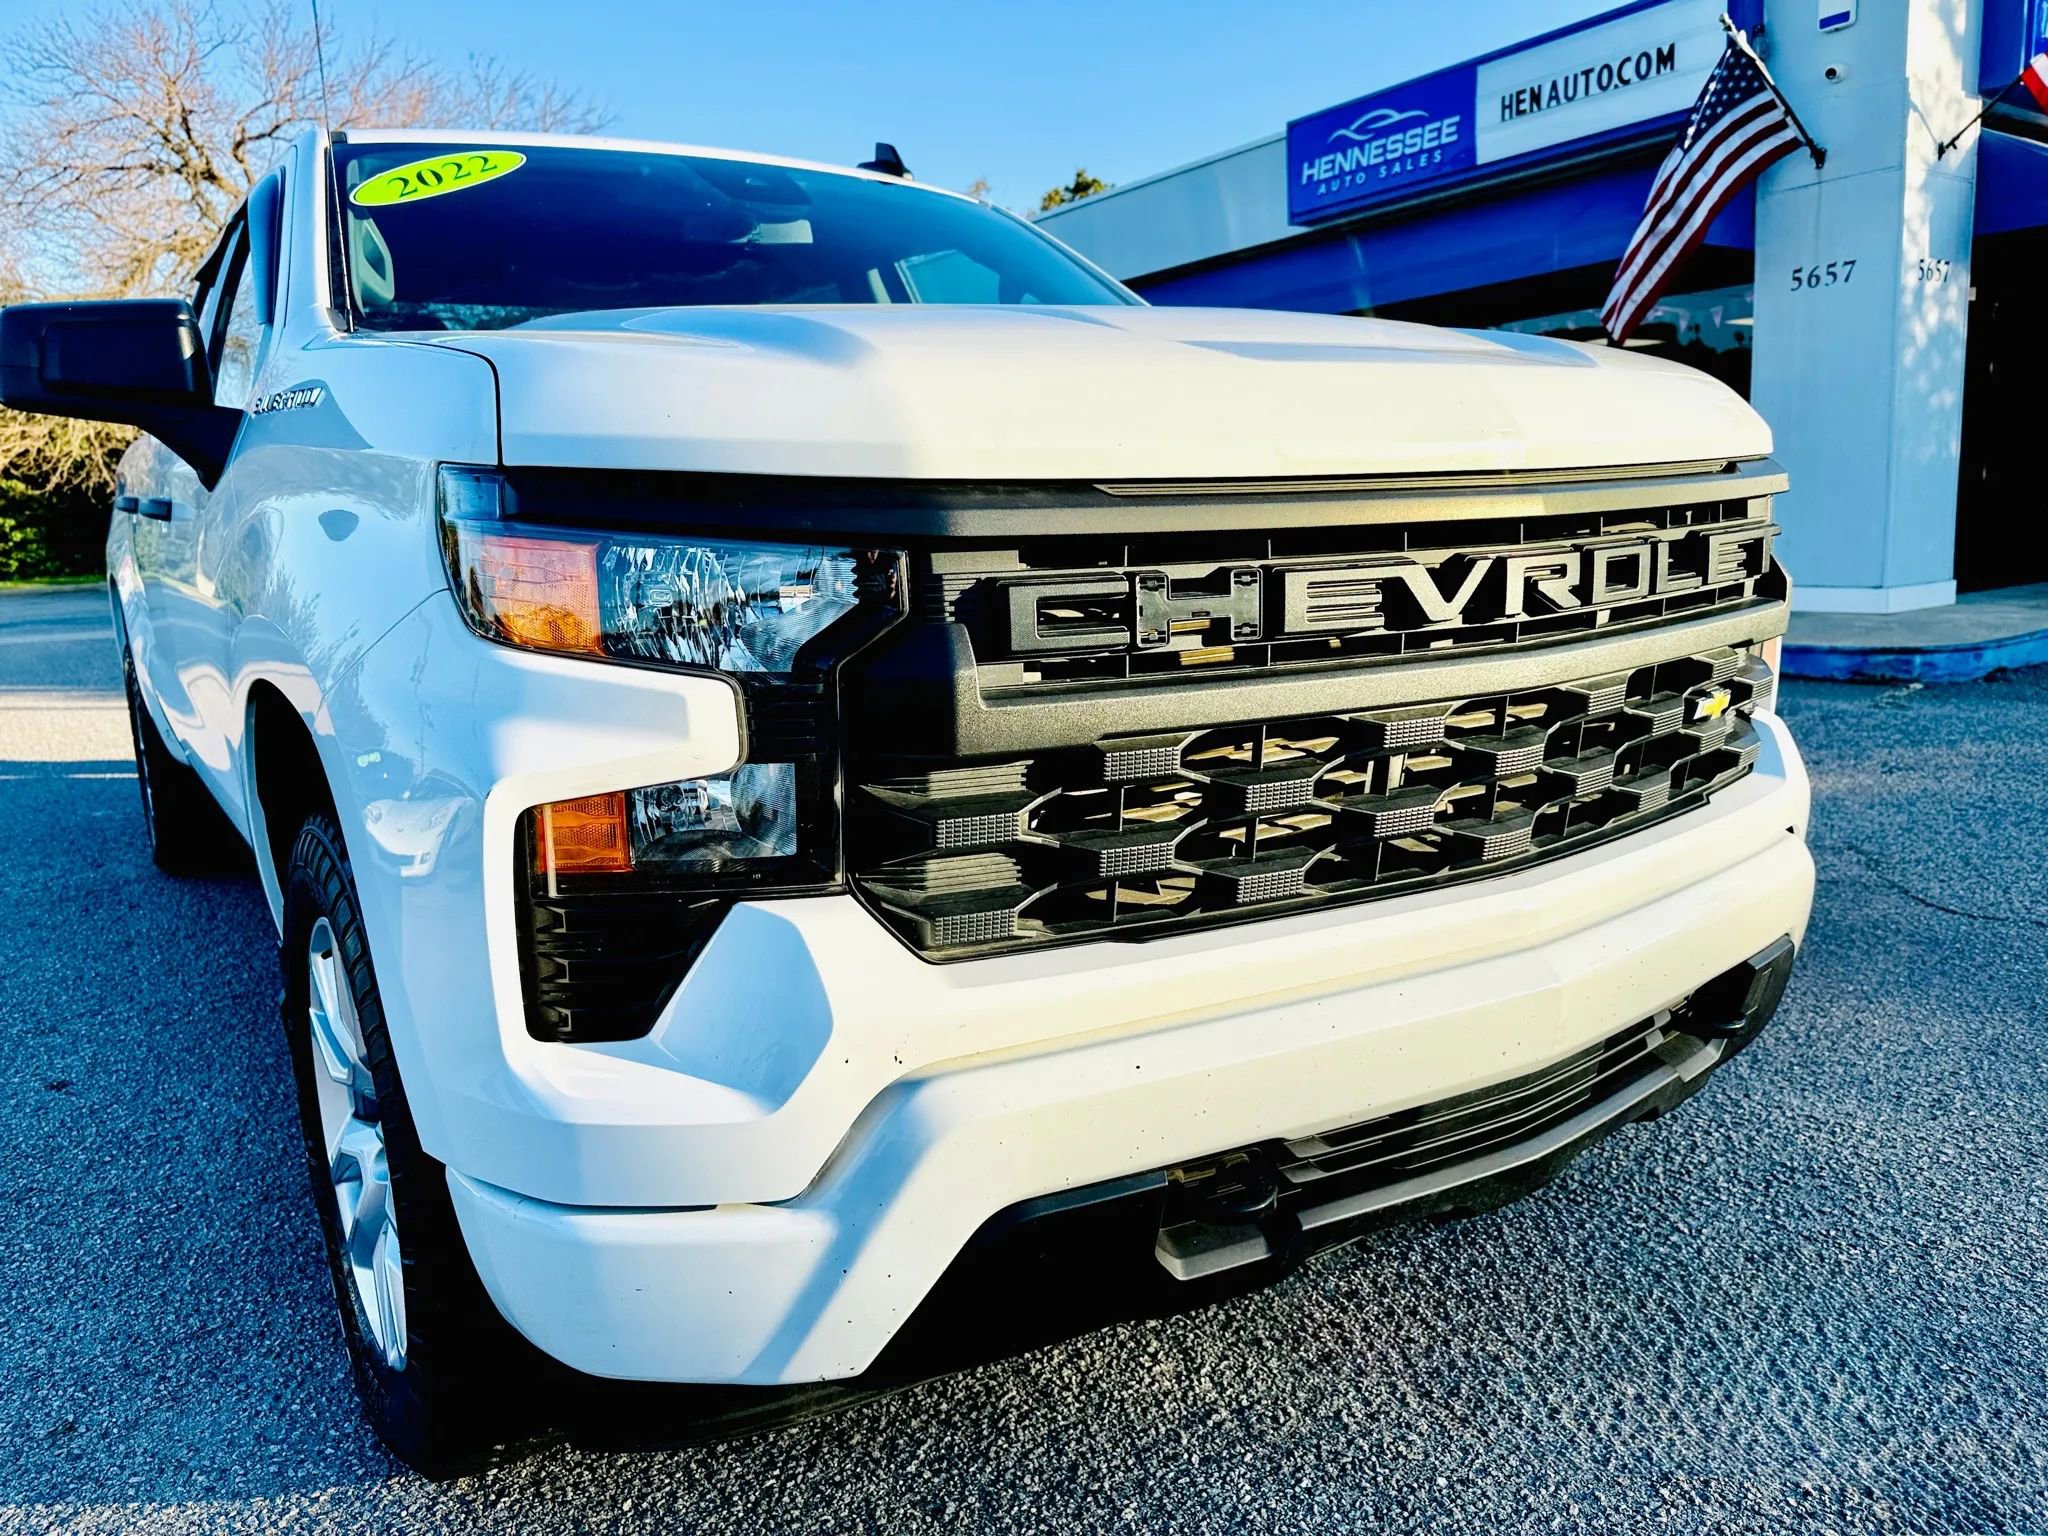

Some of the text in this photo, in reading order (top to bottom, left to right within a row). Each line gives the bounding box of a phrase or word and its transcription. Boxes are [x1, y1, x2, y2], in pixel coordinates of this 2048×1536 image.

[1301, 114, 1461, 185] HENNESSEE
[1316, 149, 1442, 196] AUTO SALES
[386, 154, 498, 199] 2022
[1790, 259, 1857, 292] 5657
[1917, 258, 1950, 283] 5657
[1006, 525, 1782, 652] CHEVROLET
